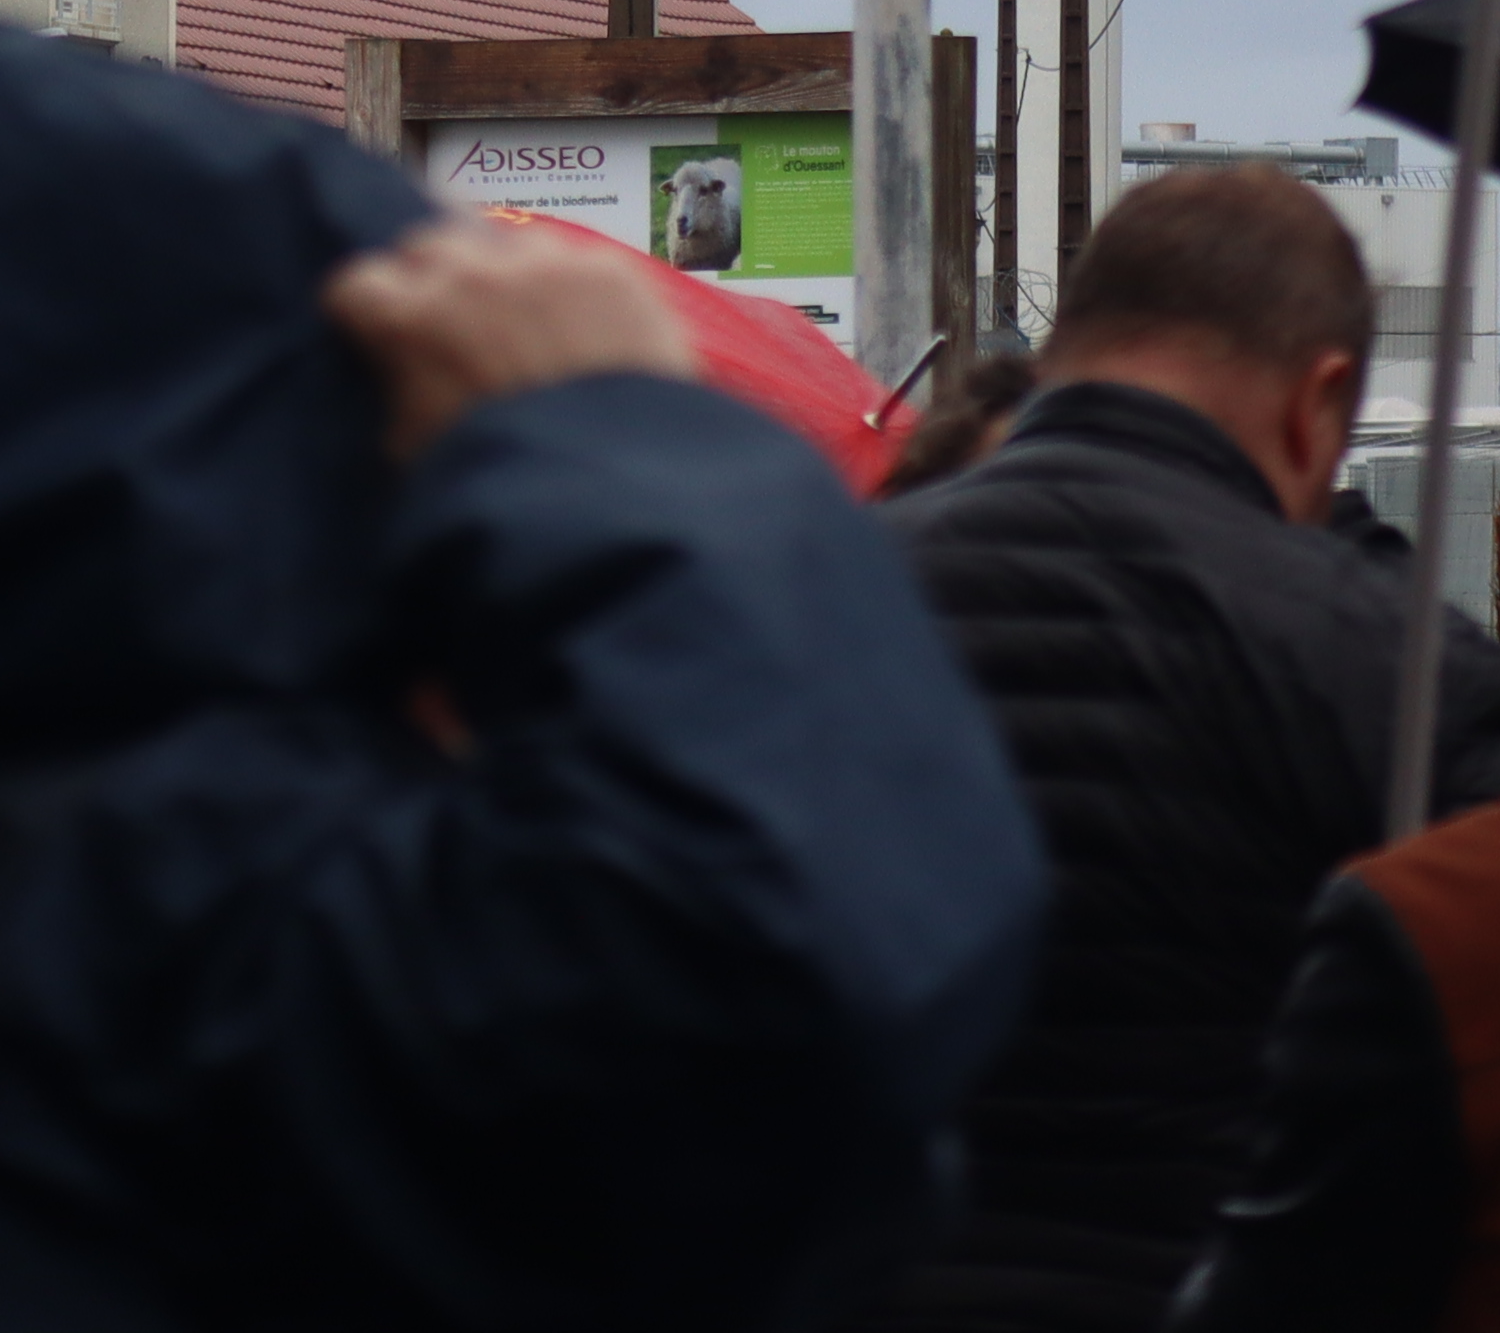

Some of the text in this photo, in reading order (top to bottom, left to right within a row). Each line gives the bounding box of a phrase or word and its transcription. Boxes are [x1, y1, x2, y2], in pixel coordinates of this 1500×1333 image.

[447, 139, 605, 182] ADISSEO
[783, 145, 840, 157] Le mouton
